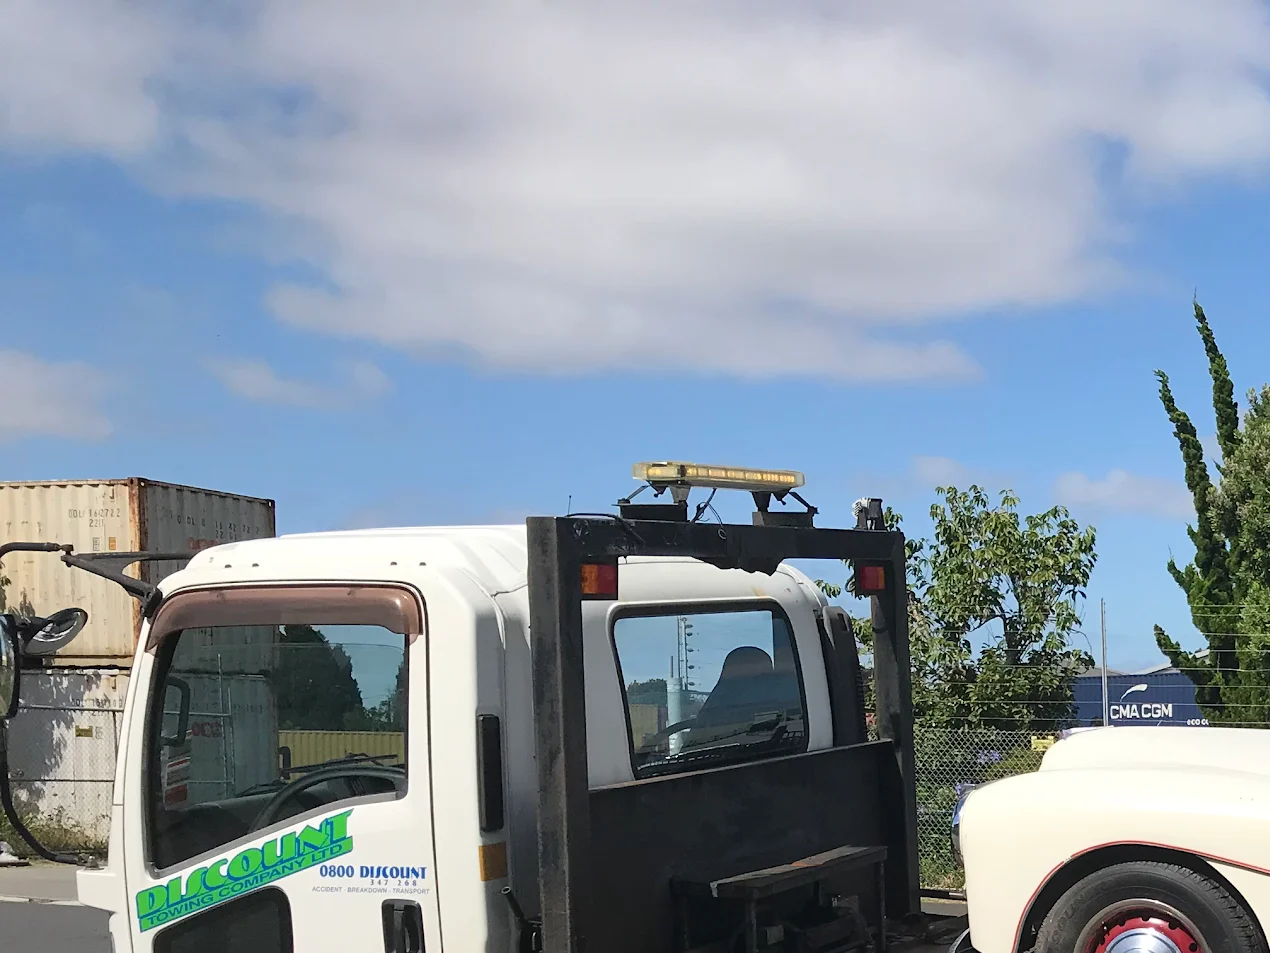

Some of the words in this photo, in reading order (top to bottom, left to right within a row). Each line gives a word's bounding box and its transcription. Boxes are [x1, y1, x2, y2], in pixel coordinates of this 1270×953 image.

[1109, 704, 1140, 720] CMA
[1141, 703, 1173, 718] CGM
[136, 808, 353, 919] DISCOUNT
[319, 865, 355, 878] 0800
[359, 865, 427, 880] DISCOUNT
[147, 886, 214, 925] TOWING
[218, 855, 306, 898] COMPANY
[310, 843, 343, 863] LTD
[347, 886, 387, 894] BREAKDOWN
[392, 887, 430, 895] TRANSPORT
